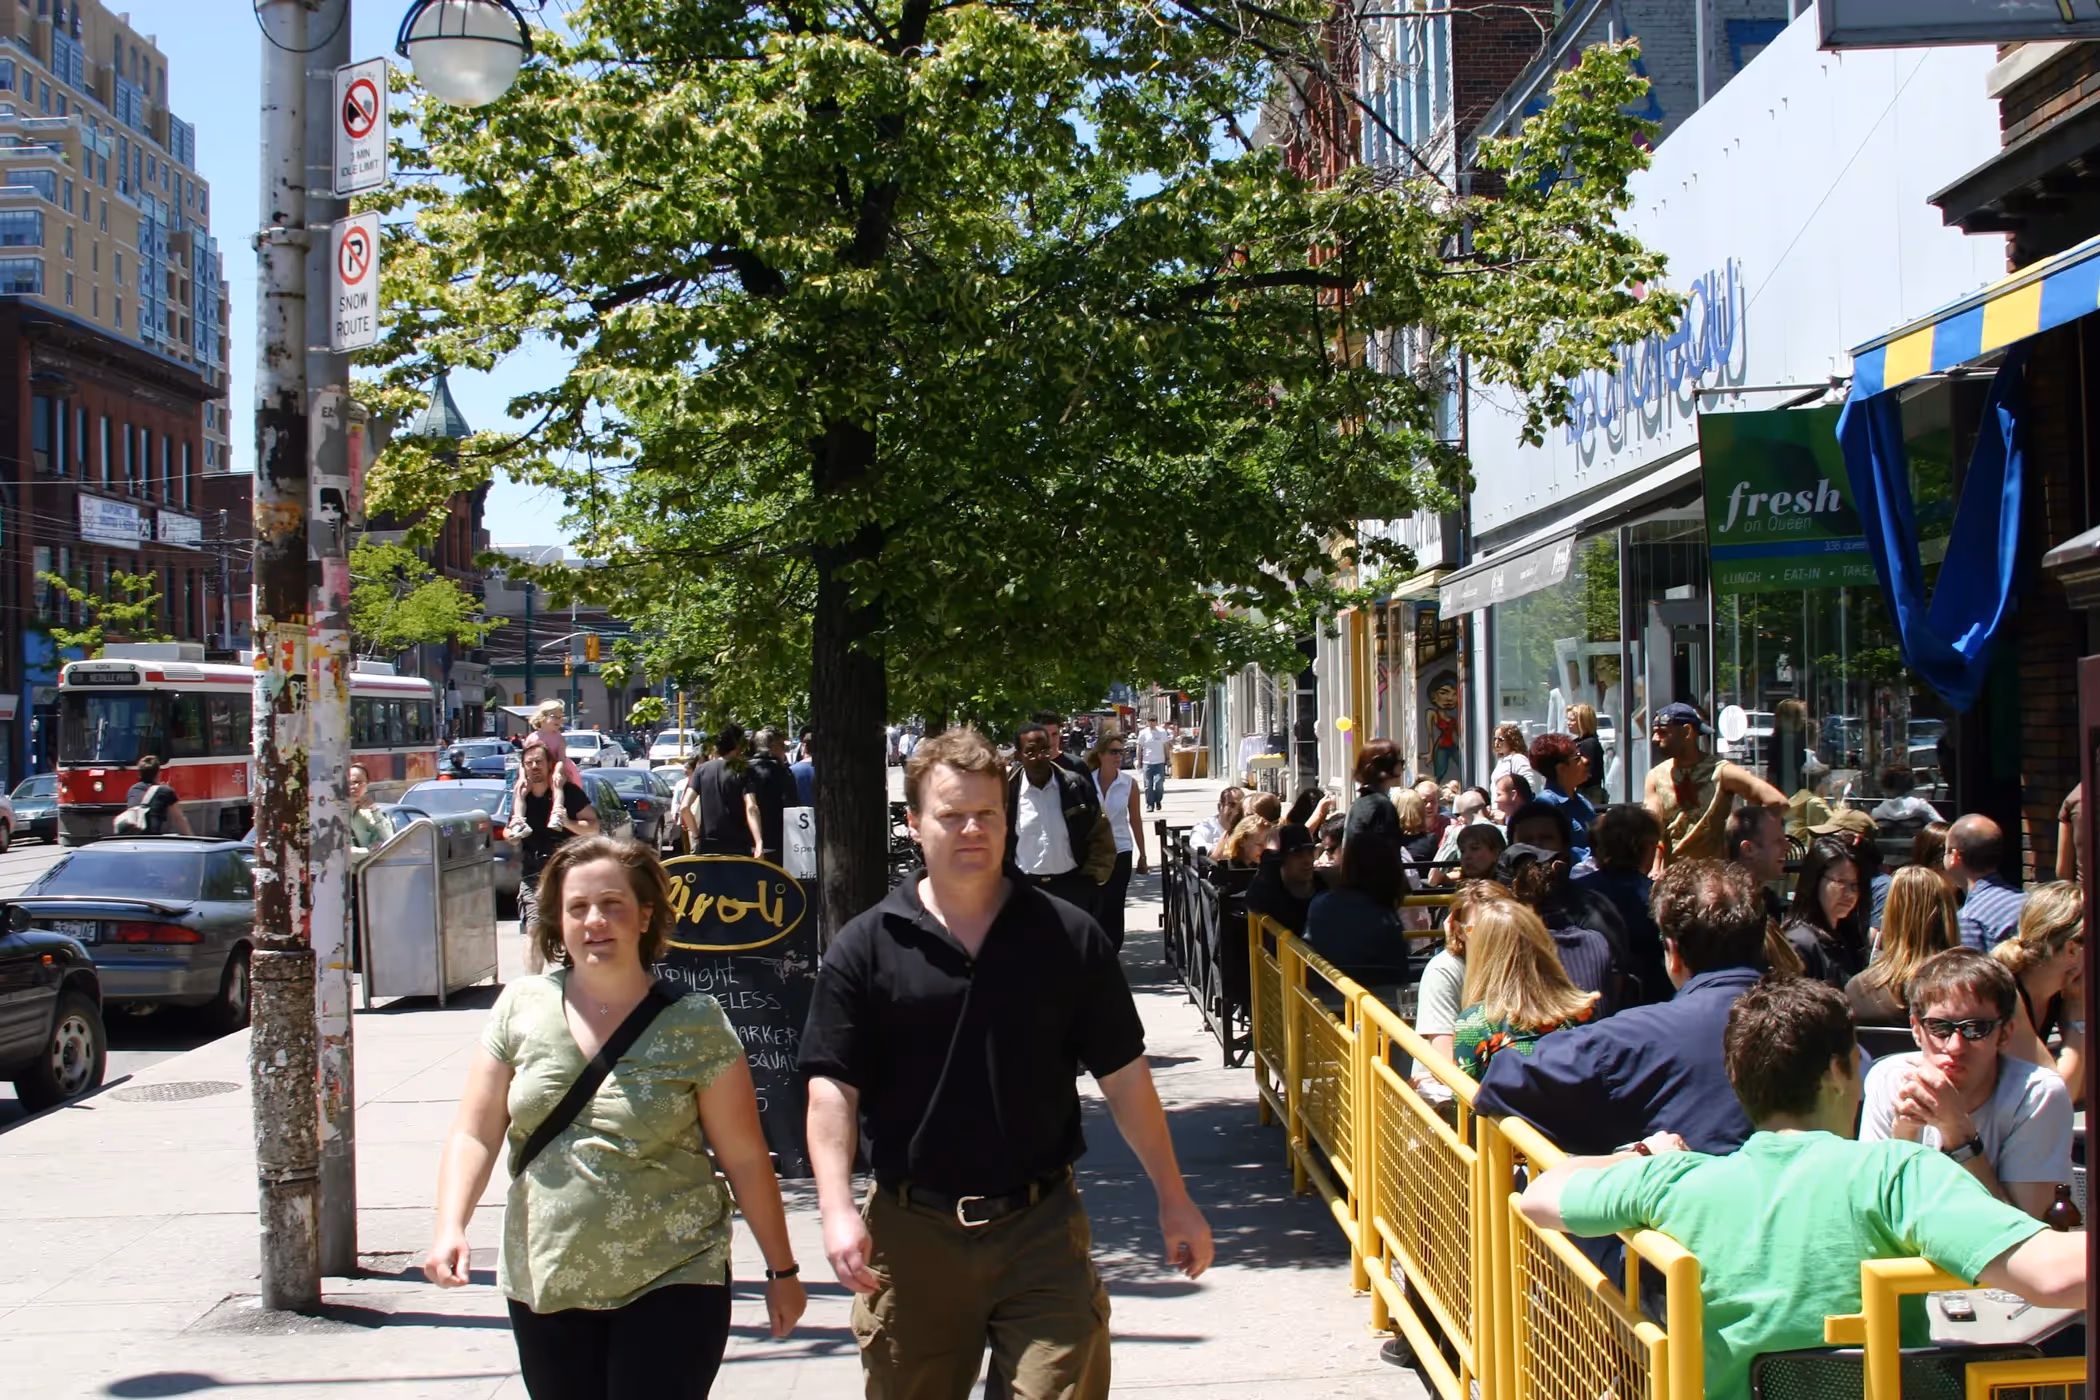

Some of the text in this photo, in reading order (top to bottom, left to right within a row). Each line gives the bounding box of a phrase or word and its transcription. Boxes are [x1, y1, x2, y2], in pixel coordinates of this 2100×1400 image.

[356, 148, 371, 159] MIN
[340, 159, 380, 177] IDLE LIMIT
[339, 291, 369, 313] SNOW
[336, 315, 370, 337] ROUTE
[1718, 478, 1841, 533] fresh
[1744, 515, 1813, 533] on Queen
[1723, 565, 1869, 584] LUNCH EAT-IN TAKE
[717, 992, 782, 1010] ELESS
